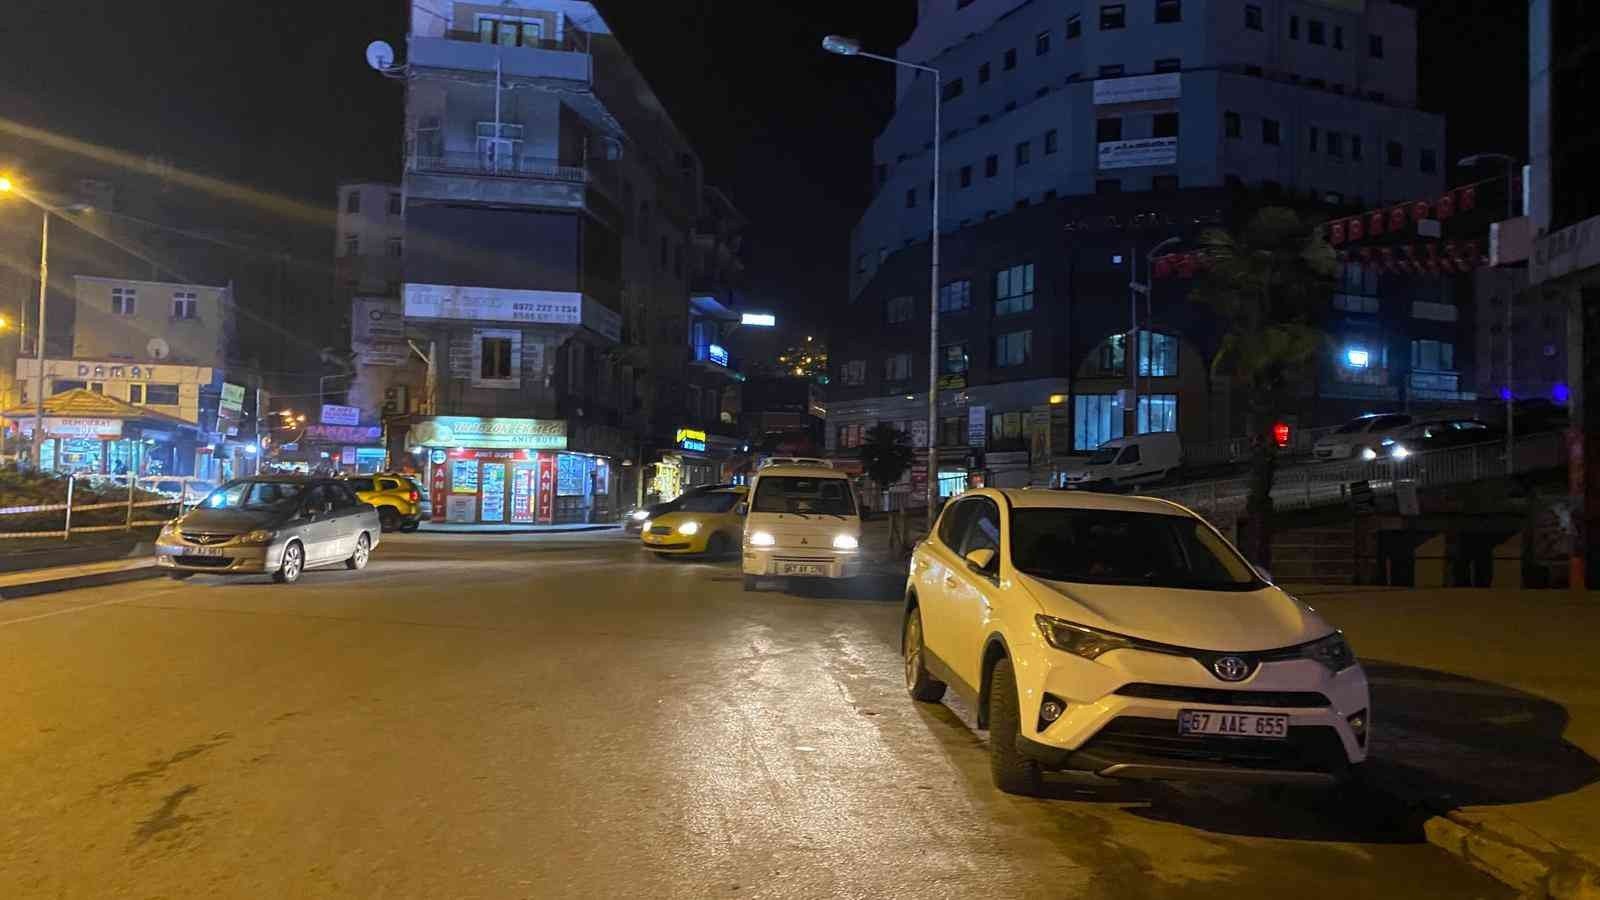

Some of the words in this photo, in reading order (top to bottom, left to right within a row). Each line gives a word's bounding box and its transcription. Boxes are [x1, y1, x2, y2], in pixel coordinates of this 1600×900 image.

[78, 364, 155, 379] DAMAT
[435, 468, 444, 514] ANIT
[541, 469, 550, 514] ANIT
[1191, 714, 1210, 731] 67
[1218, 715, 1248, 733] AAE
[1255, 717, 1285, 735] 655
